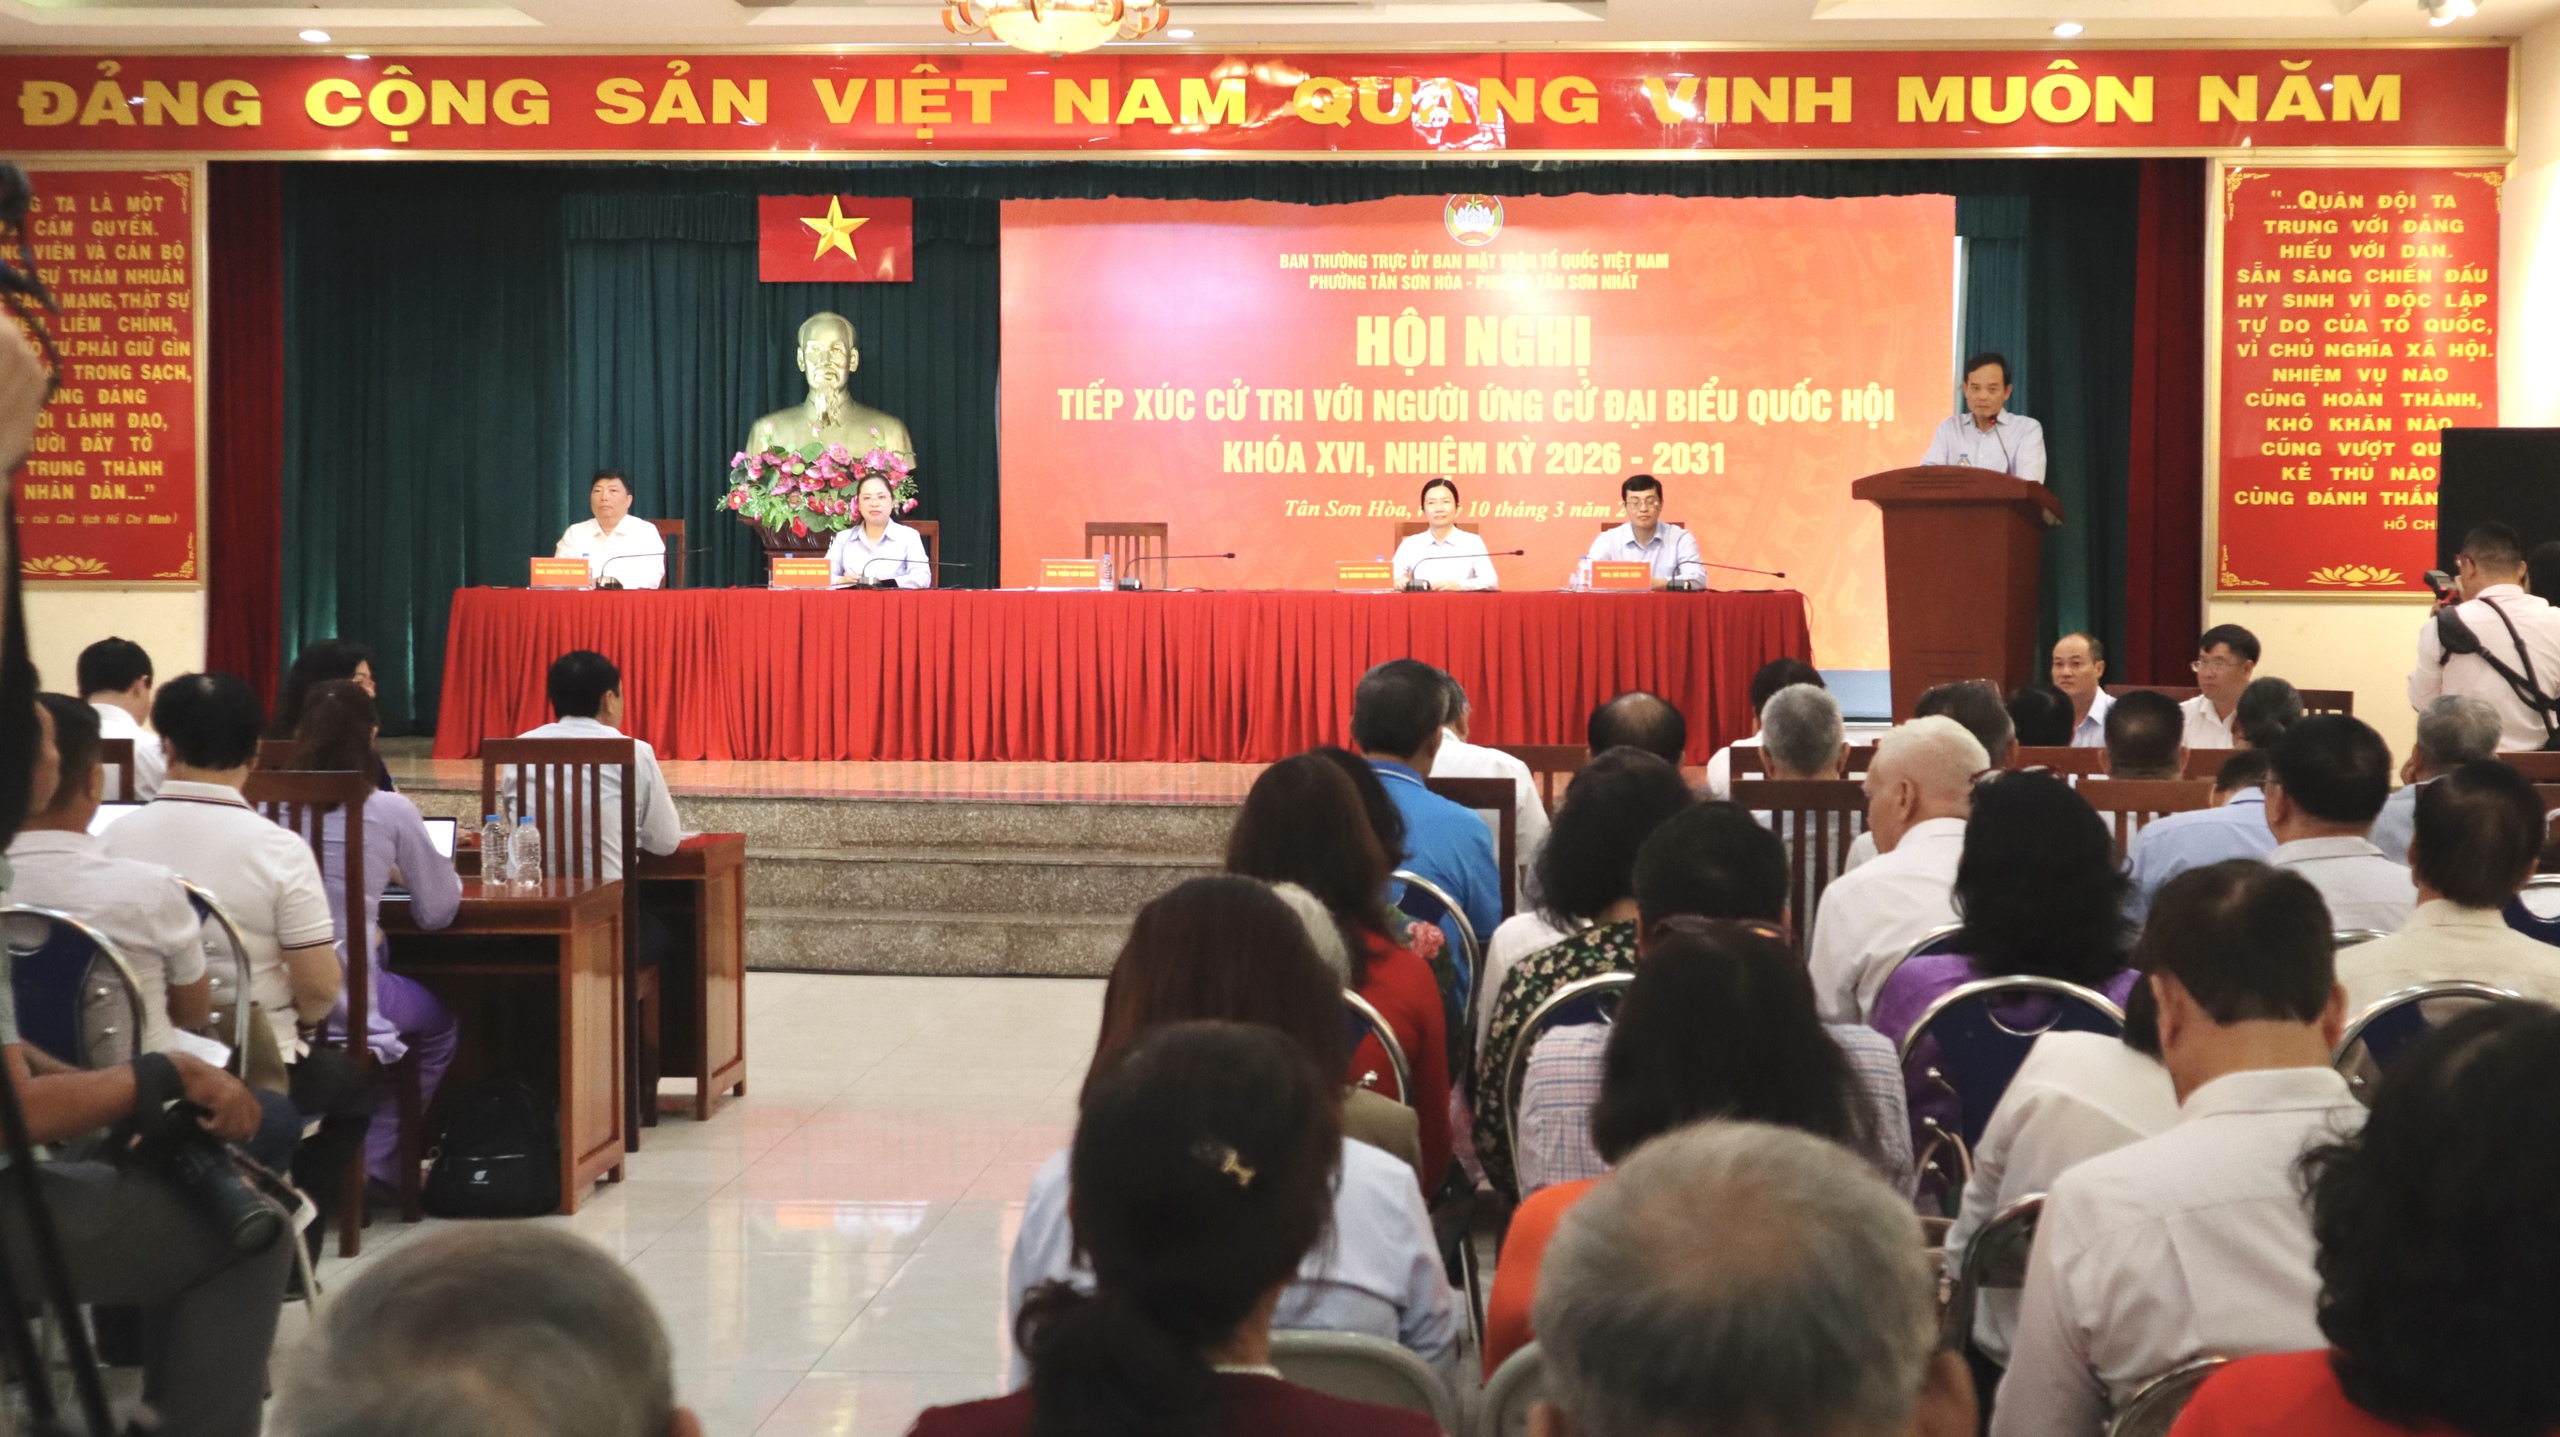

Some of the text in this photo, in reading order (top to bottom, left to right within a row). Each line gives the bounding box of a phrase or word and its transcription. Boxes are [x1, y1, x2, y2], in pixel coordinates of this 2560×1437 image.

[17, 58, 2400, 143] ĐẢNG CỘNG SẢN VIỆT NAM QUANG VINH MUÔN NĂM
[2378, 190, 2416, 214] ĐỘI
[2431, 194, 2457, 209] TA
[2263, 213, 2465, 234] TRUNG VỚI ĐẢNG
[2280, 238, 2454, 259] HIẾU VỚI DÂN.
[1279, 254, 1309, 269] BAN
[1312, 250, 1368, 269] THƯỜNG
[1432, 254, 1462, 269] BAN
[1636, 254, 1669, 269] NAM
[1309, 271, 1367, 290] PHƯỜNG
[1370, 272, 1398, 290] TÂN
[1401, 274, 1431, 290] SƠN
[1568, 274, 1598, 290] SƠN
[2237, 261, 2488, 283] SẴN SÀNG CHIẾN ĐẤU
[2237, 293, 2268, 308] HY
[2283, 293, 2334, 308] SINH
[2349, 288, 2371, 308] VÌ
[2238, 316, 2268, 338] TỰ
[2280, 319, 2310, 333] DO
[2324, 313, 2369, 333] CỦA
[2424, 311, 2493, 335] QUỐC,
[1357, 307, 1591, 376] HỘI NGHỊ
[2237, 338, 2494, 362] VÌ CHỦ NGHĨA XÃ HỘI.
[73, 364, 132, 380] TRONG
[2273, 363, 2449, 387] NHIỆM VỤ NÀO
[1058, 376, 1895, 429] TIẾP XÚC CỬ TRI VỚI NGƯỜI ỨNG CỬ ĐẠI BIỂU QUỐC HỘI
[2245, 388, 2483, 409] CŨNG HOÀN THÀNH,
[2267, 412, 2453, 432] KHÓ KHĂN NÀO
[1223, 434, 1307, 474] KHÓA
[1315, 441, 1374, 478] XVI,
[1384, 435, 1487, 480] NHIỆM
[1496, 435, 1537, 474] KỲ
[1545, 442, 1621, 475] 2026
[1652, 442, 1725, 475] 2031
[2261, 437, 2442, 461] CŨNG VƯỢT QU
[27, 460, 86, 476] TRUNG
[2282, 461, 2437, 481] KẺ THÙ NÀO
[2307, 487, 2367, 505] ĐÁNH
[2379, 484, 2439, 505] THẮN
[1284, 500, 1319, 517] Tân
[1324, 500, 1362, 517] Sơn
[1367, 500, 1412, 520] Hòa,
[1468, 500, 1488, 518] 10
[1494, 500, 1548, 521] tháng
[1552, 501, 1565, 518] 3
[1569, 501, 1611, 518] năm
[2412, 520, 2438, 530] CH
